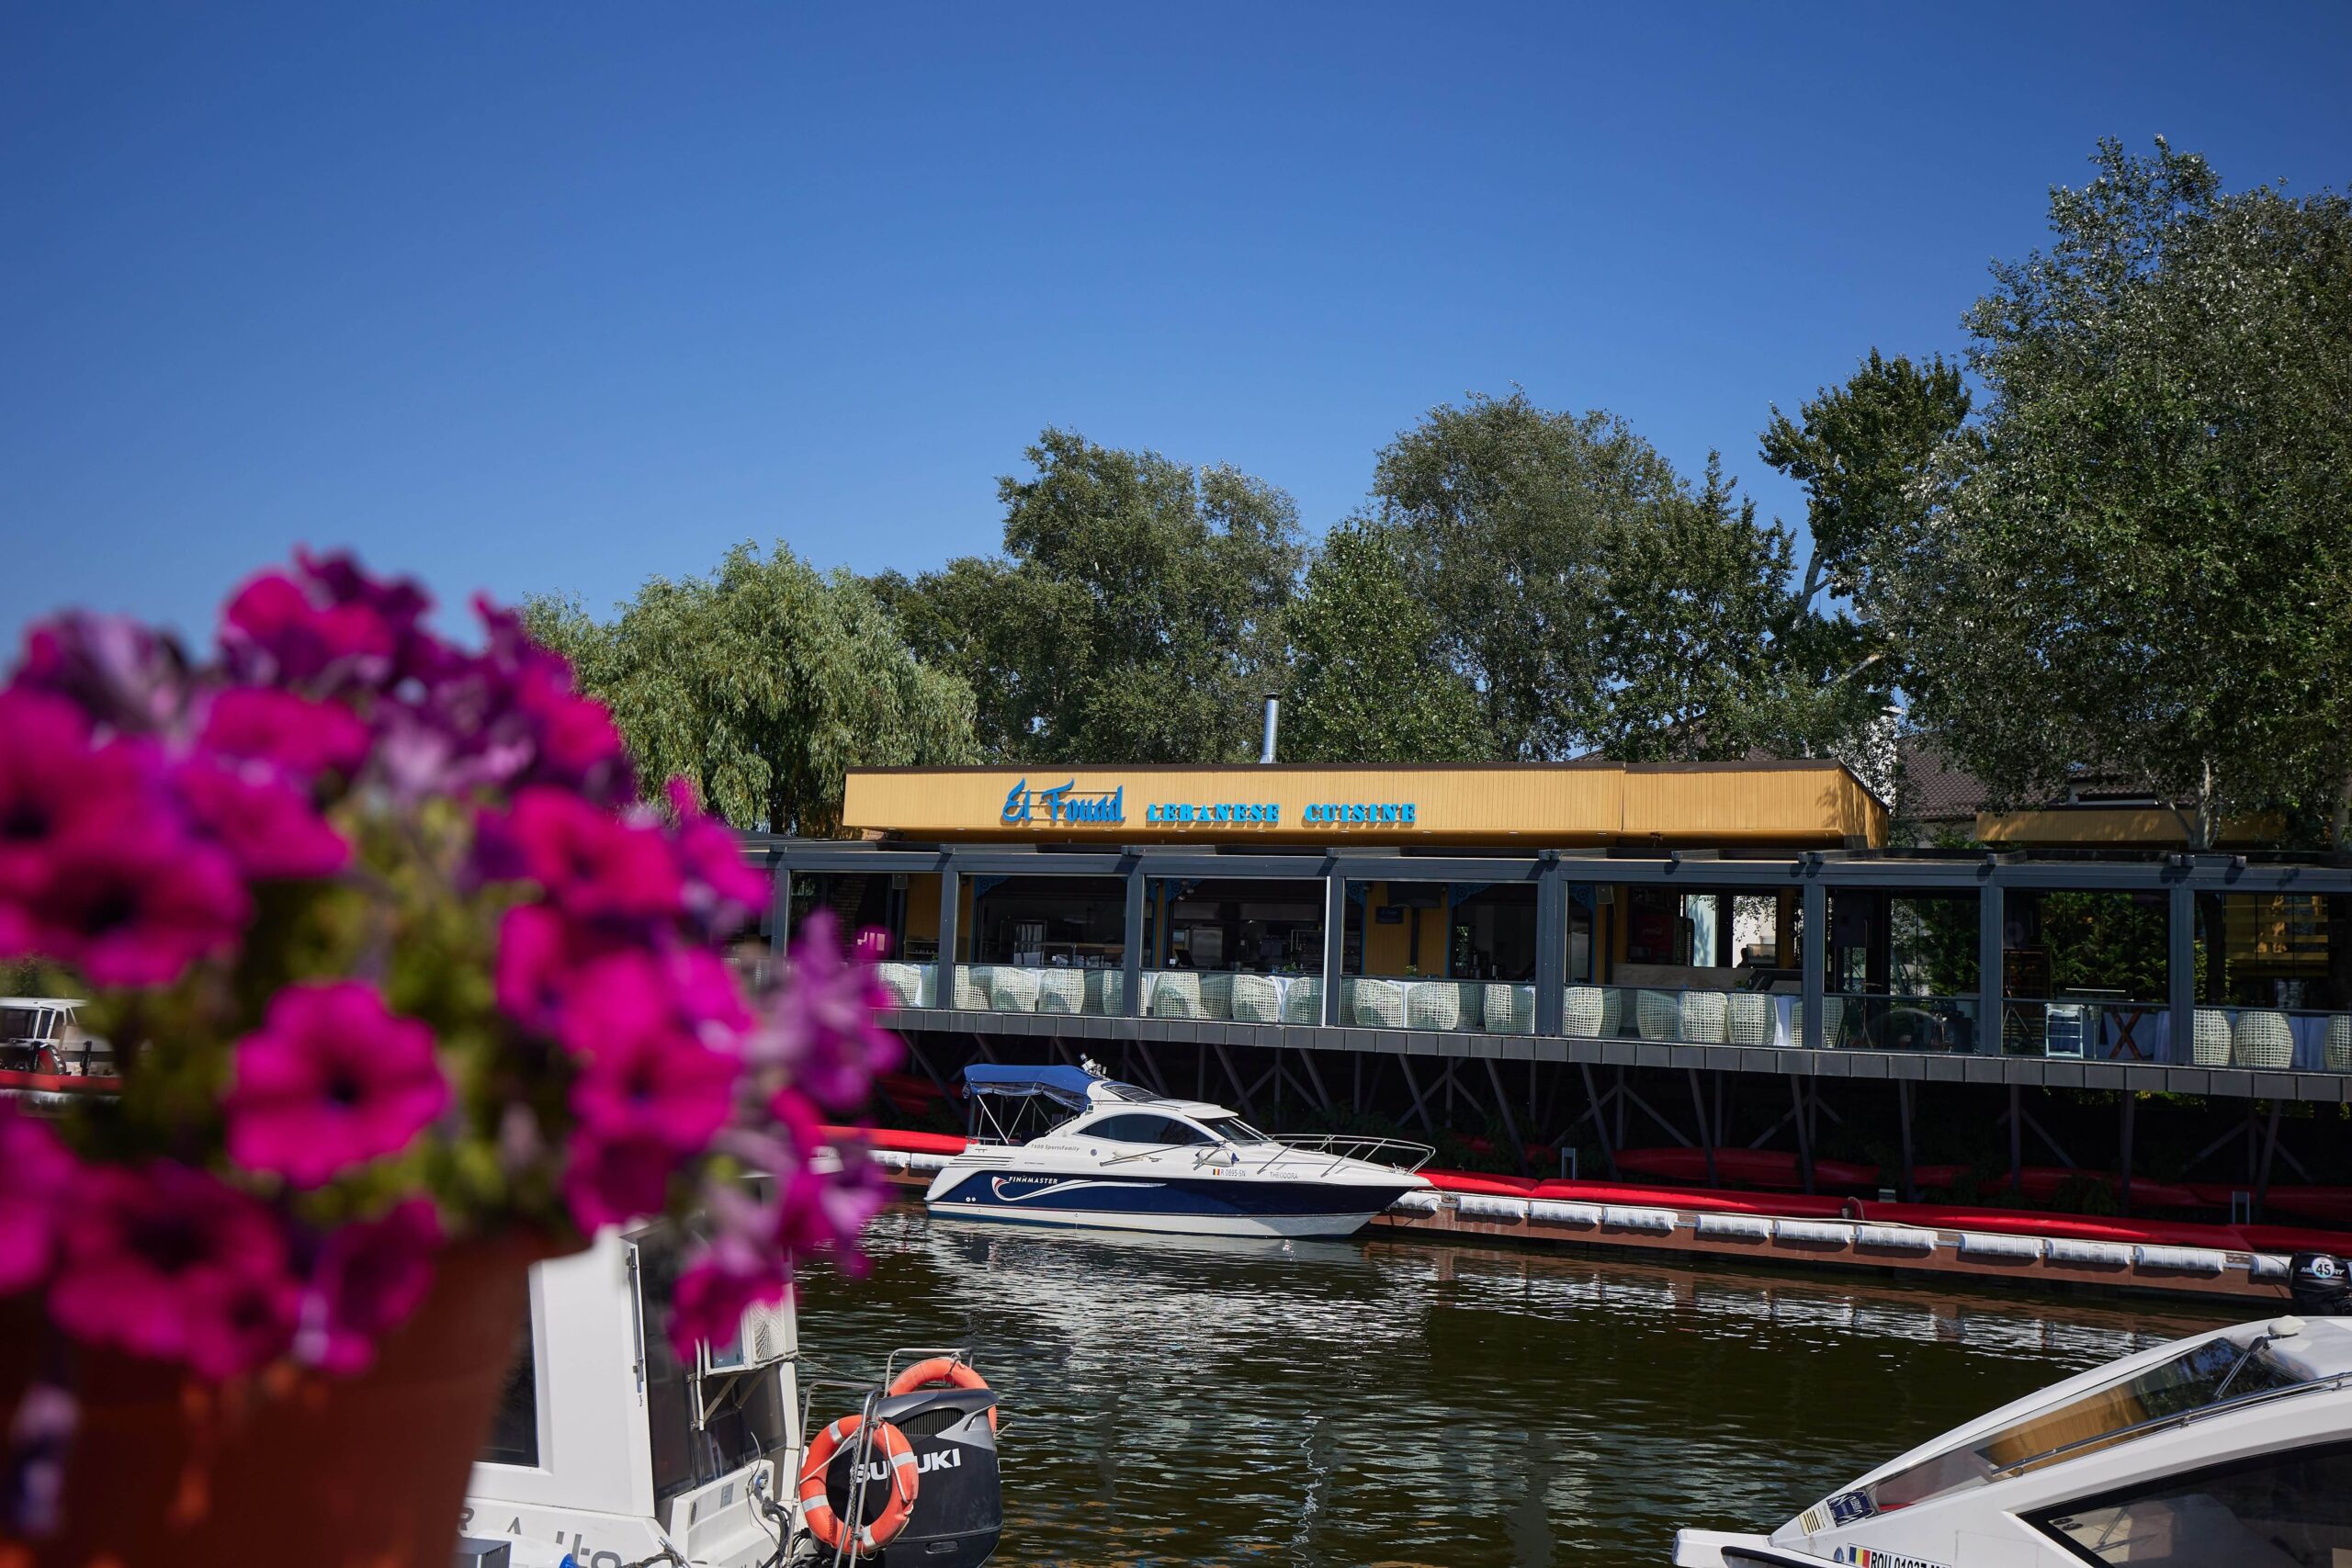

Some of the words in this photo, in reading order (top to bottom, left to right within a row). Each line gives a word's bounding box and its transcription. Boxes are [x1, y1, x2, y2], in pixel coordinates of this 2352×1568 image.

[1002, 778, 1034, 822] El
[1041, 778, 1126, 823] Fouad
[1148, 804, 1280, 822] LEBANESE
[1305, 804, 1417, 822] CUISINE
[1008, 1176, 1058, 1185] FINNMASTER
[1270, 1171, 1298, 1179] THEODORA
[2316, 1263, 2331, 1275] 45
[851, 1448, 961, 1483] SUUKI
